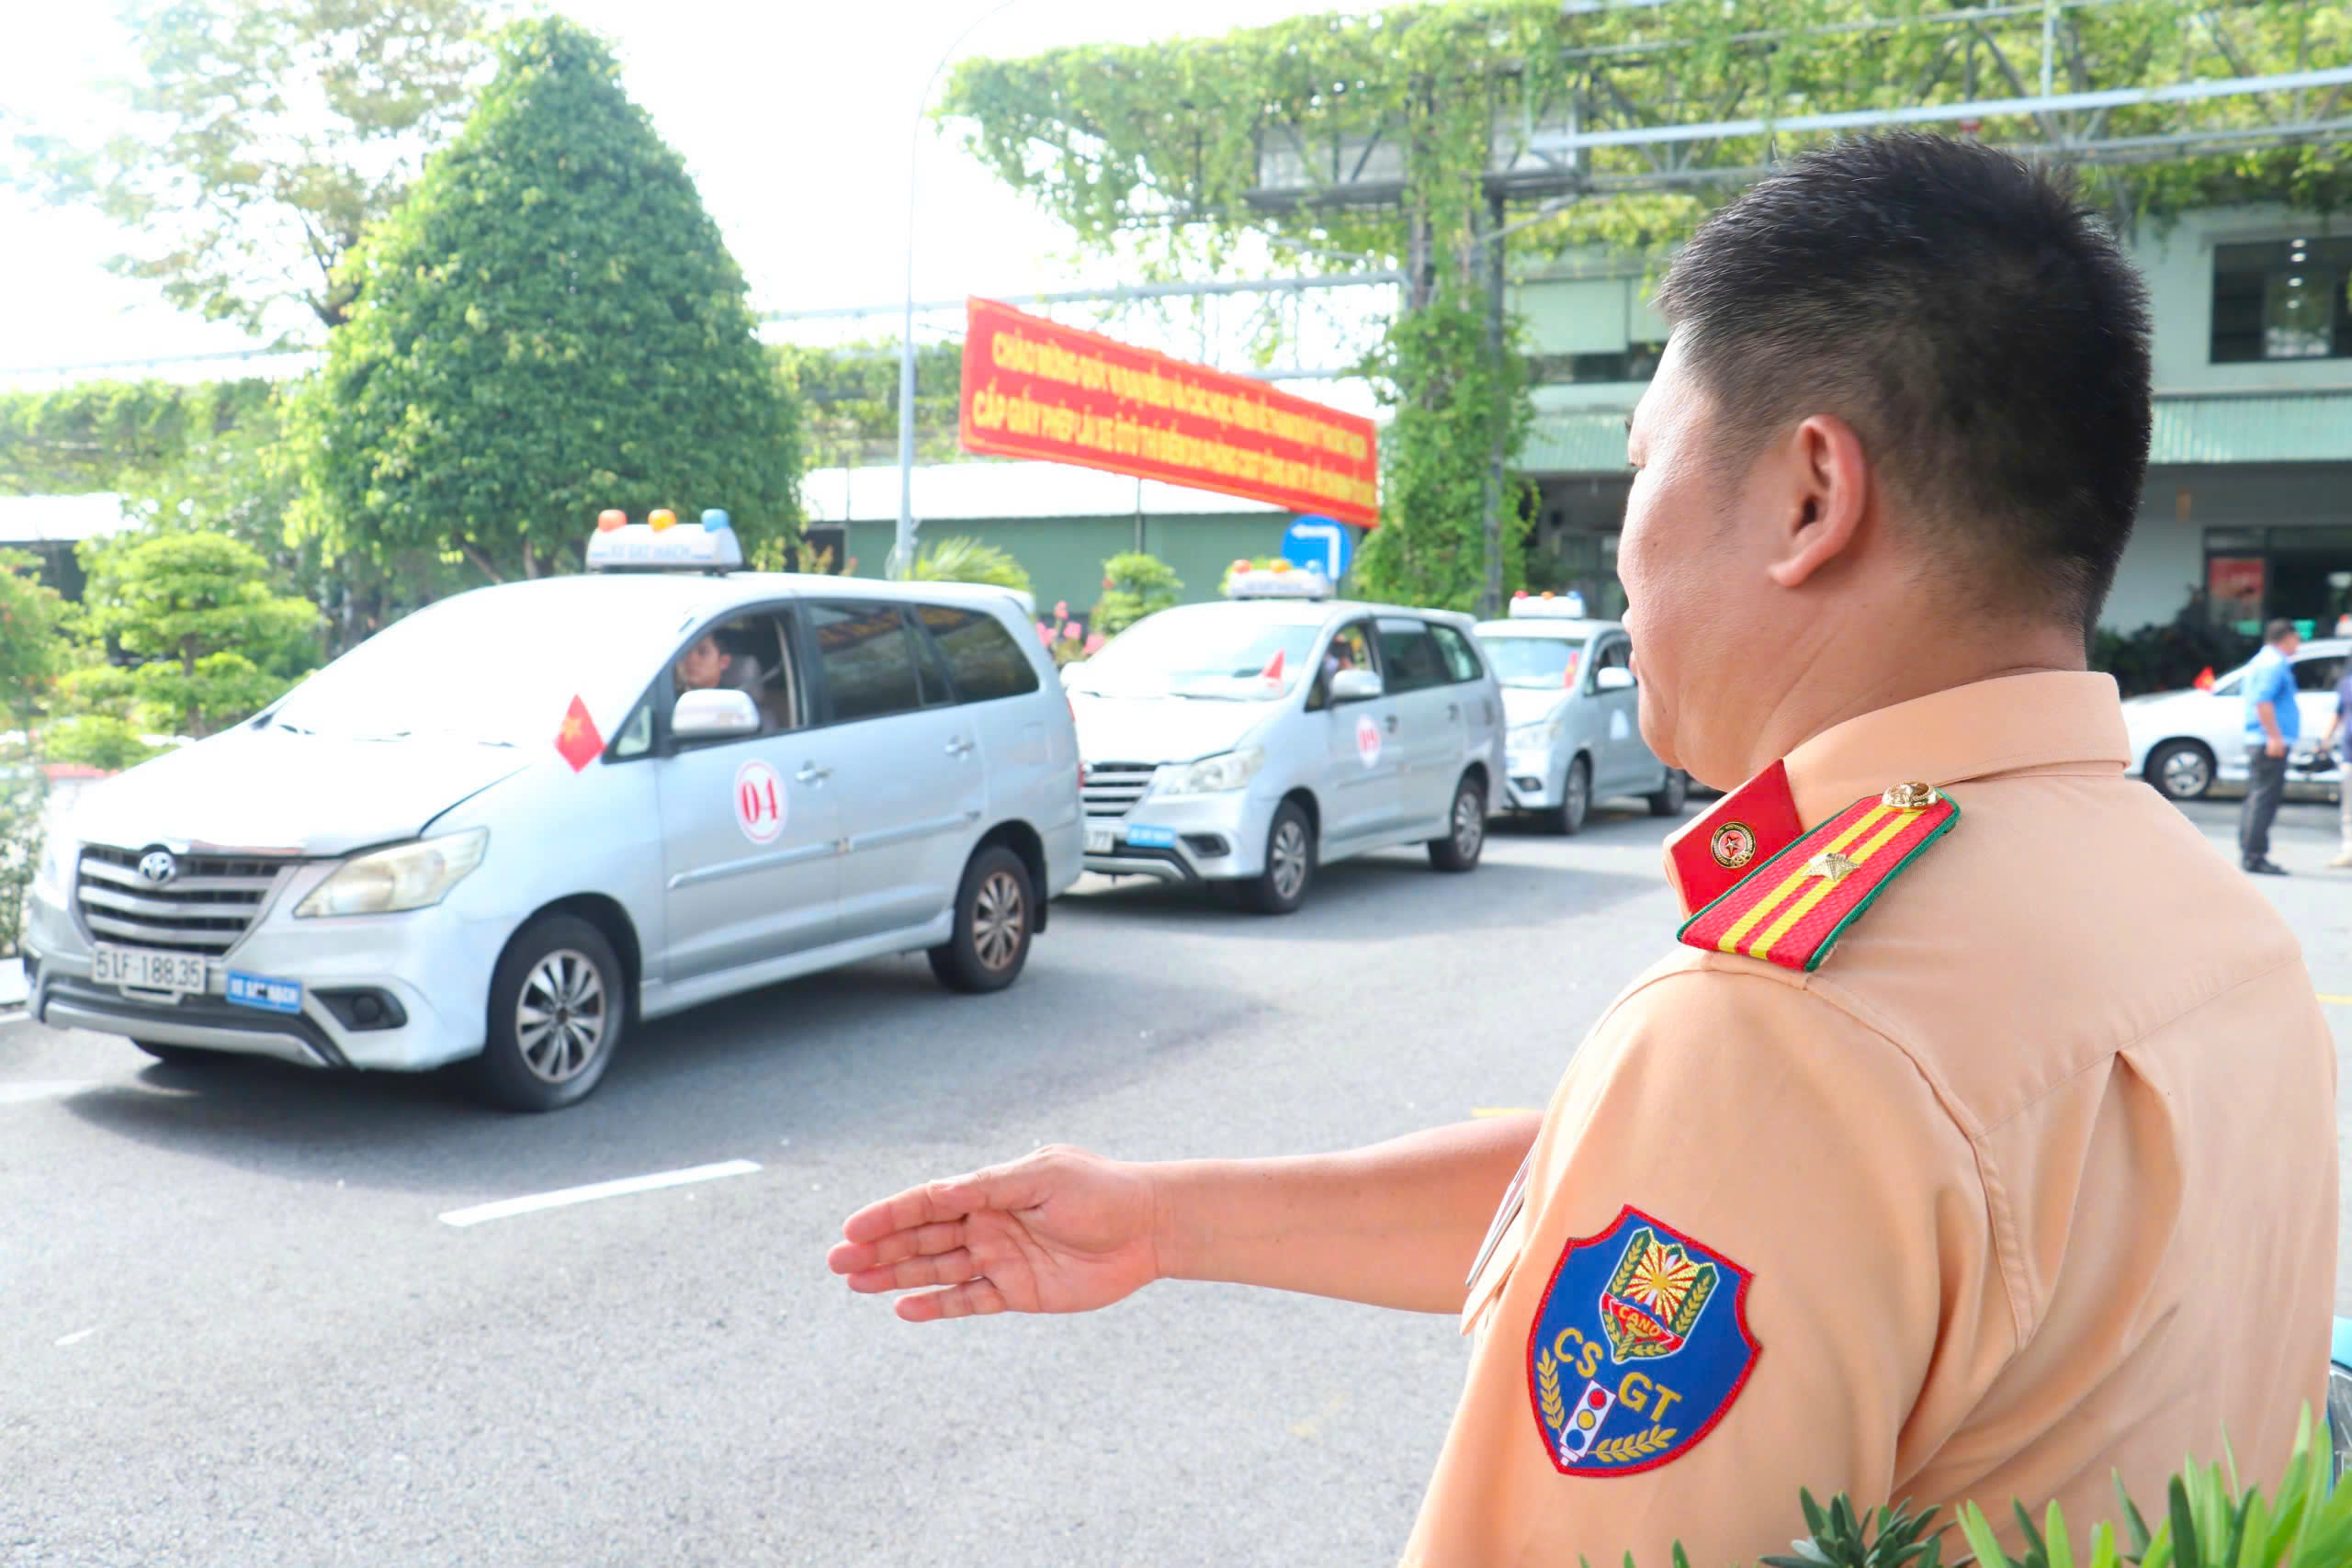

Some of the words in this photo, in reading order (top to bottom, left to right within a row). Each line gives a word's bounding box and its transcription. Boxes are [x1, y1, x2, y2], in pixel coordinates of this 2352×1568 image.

[971, 376, 1007, 431] CẤP
[741, 777, 778, 824] 04
[1618, 1305, 1662, 1337] CAND
